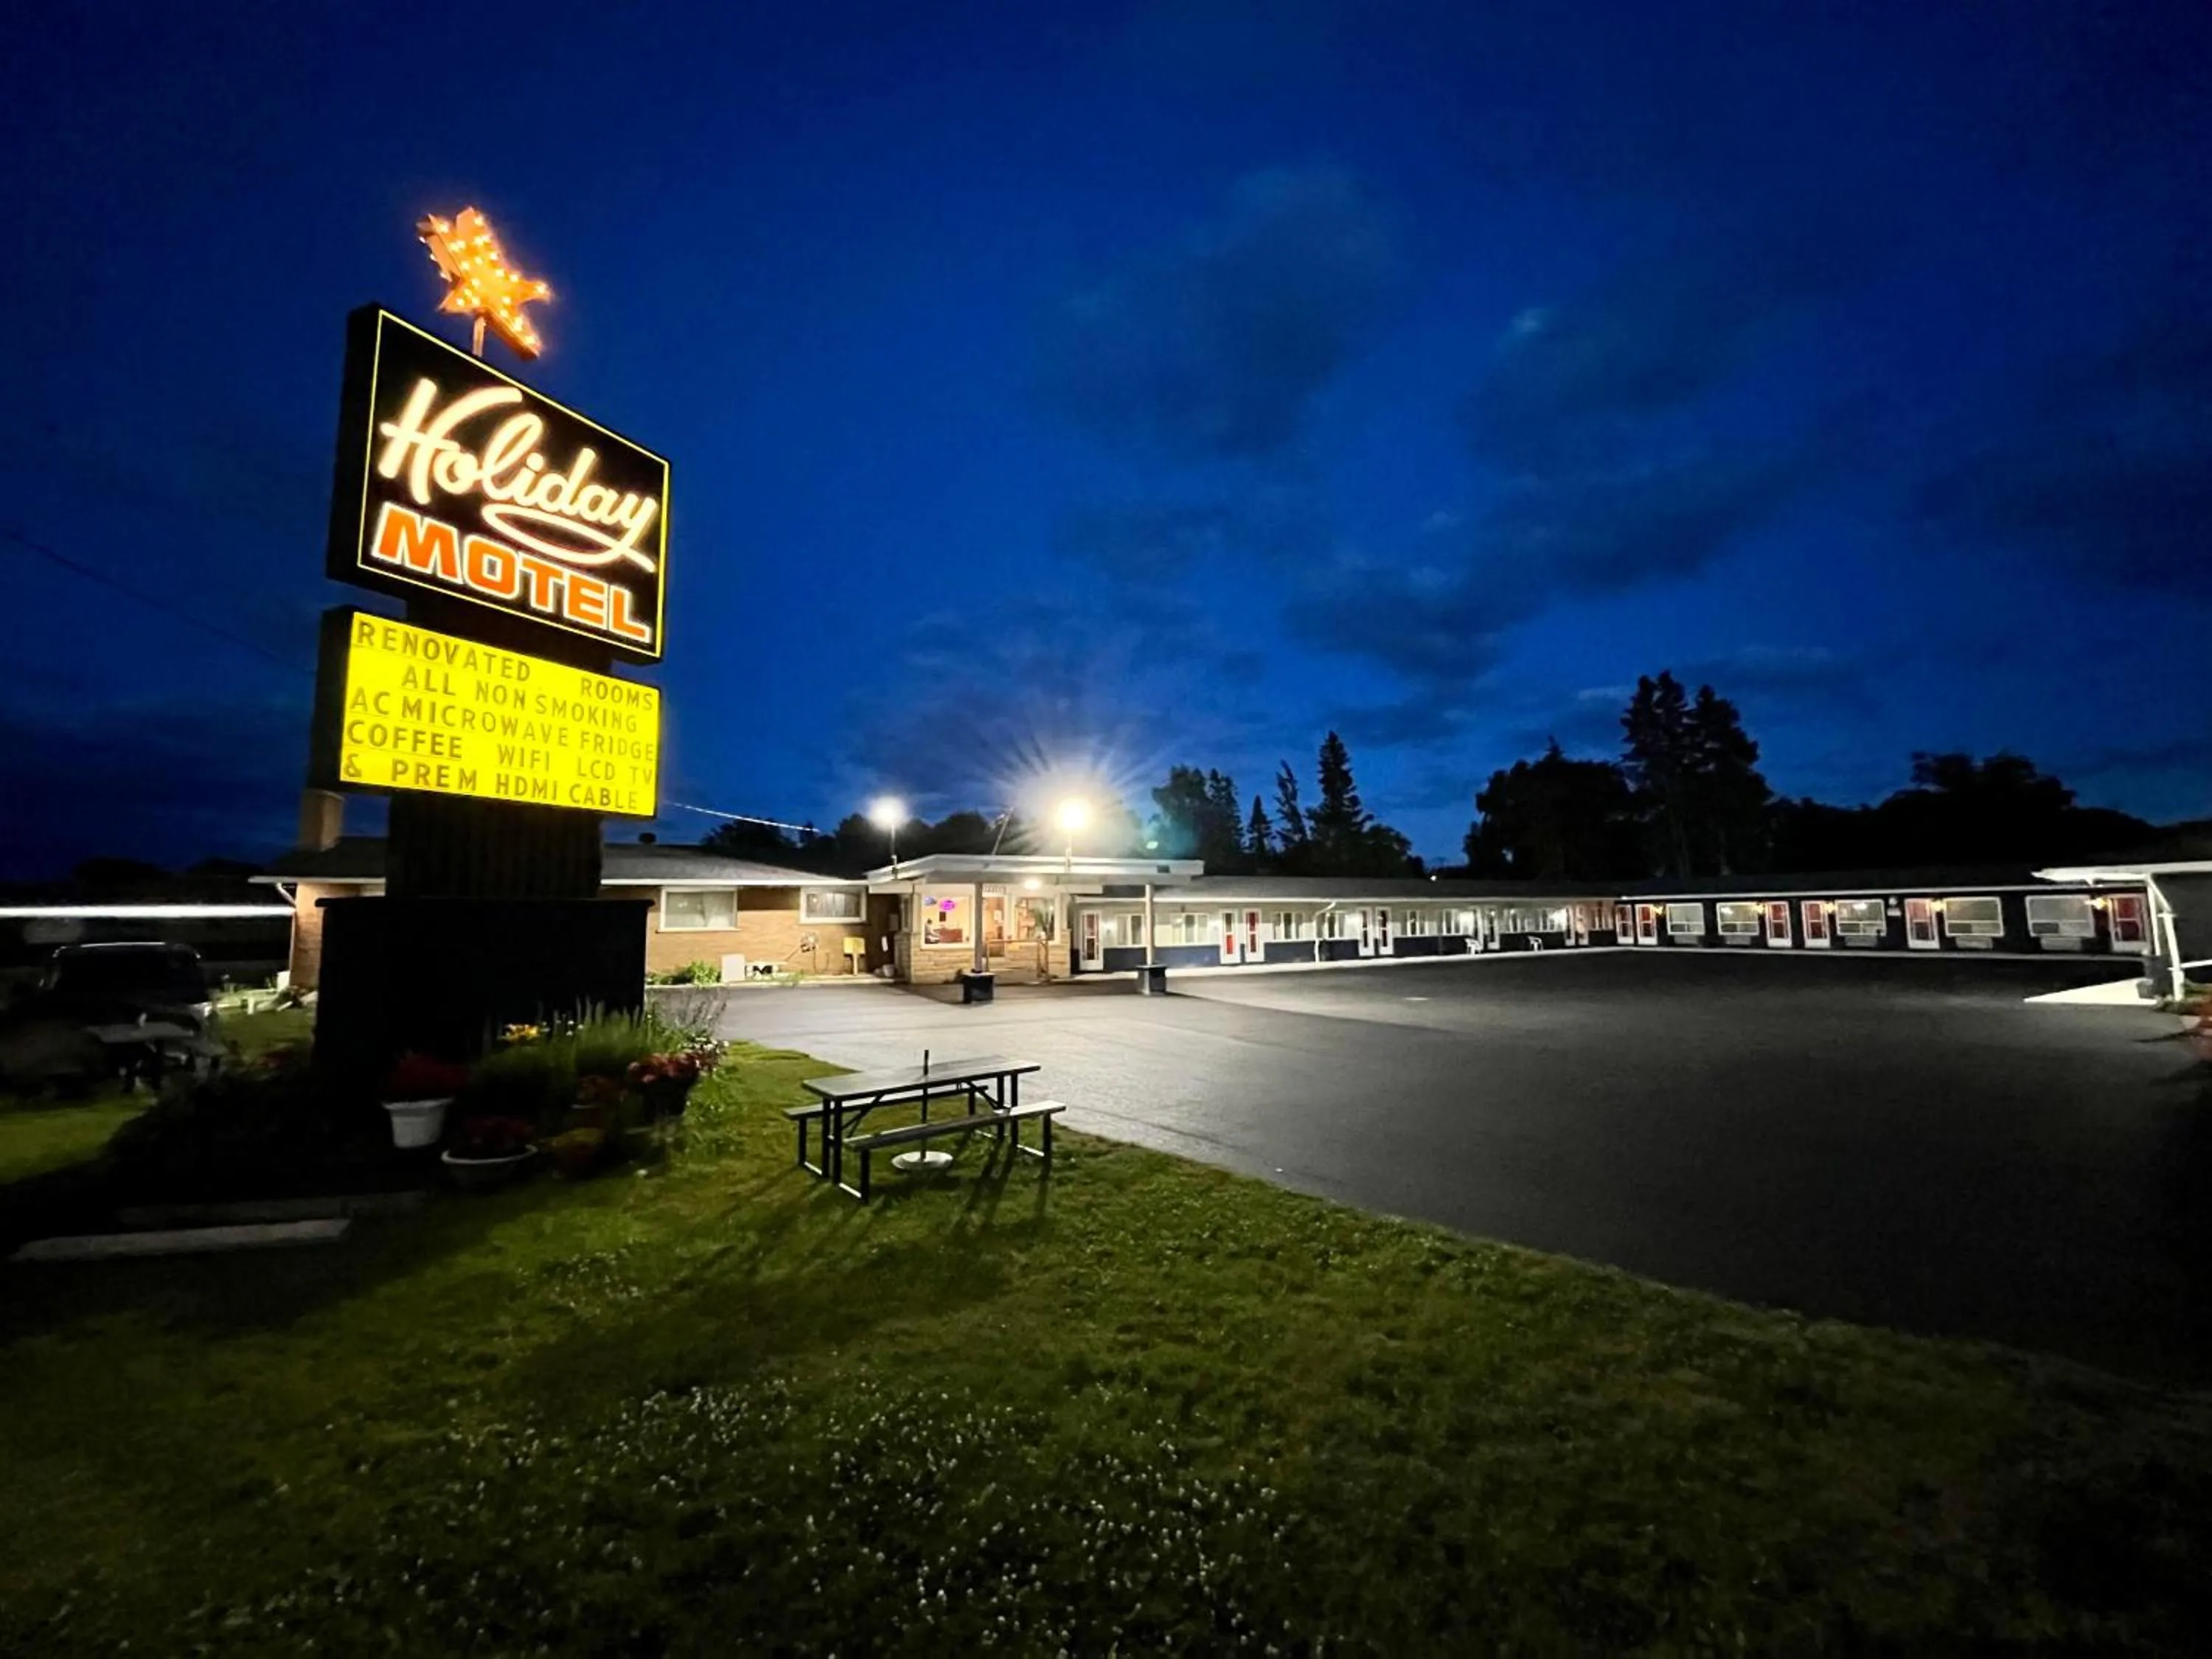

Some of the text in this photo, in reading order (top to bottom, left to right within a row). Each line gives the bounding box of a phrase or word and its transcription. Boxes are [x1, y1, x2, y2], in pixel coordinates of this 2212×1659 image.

[378, 377, 658, 573] Holiday
[371, 500, 653, 643] MOTEL
[357, 620, 653, 710] RENOVATED ROOMS
[400, 664, 636, 733] ALL NON SMOKING
[347, 719, 653, 785] COFFEE WIFI LCD TV
[349, 686, 653, 762] AC MICROWAVE FRIDGE
[344, 753, 638, 810] & PREM HDMI CABLE
